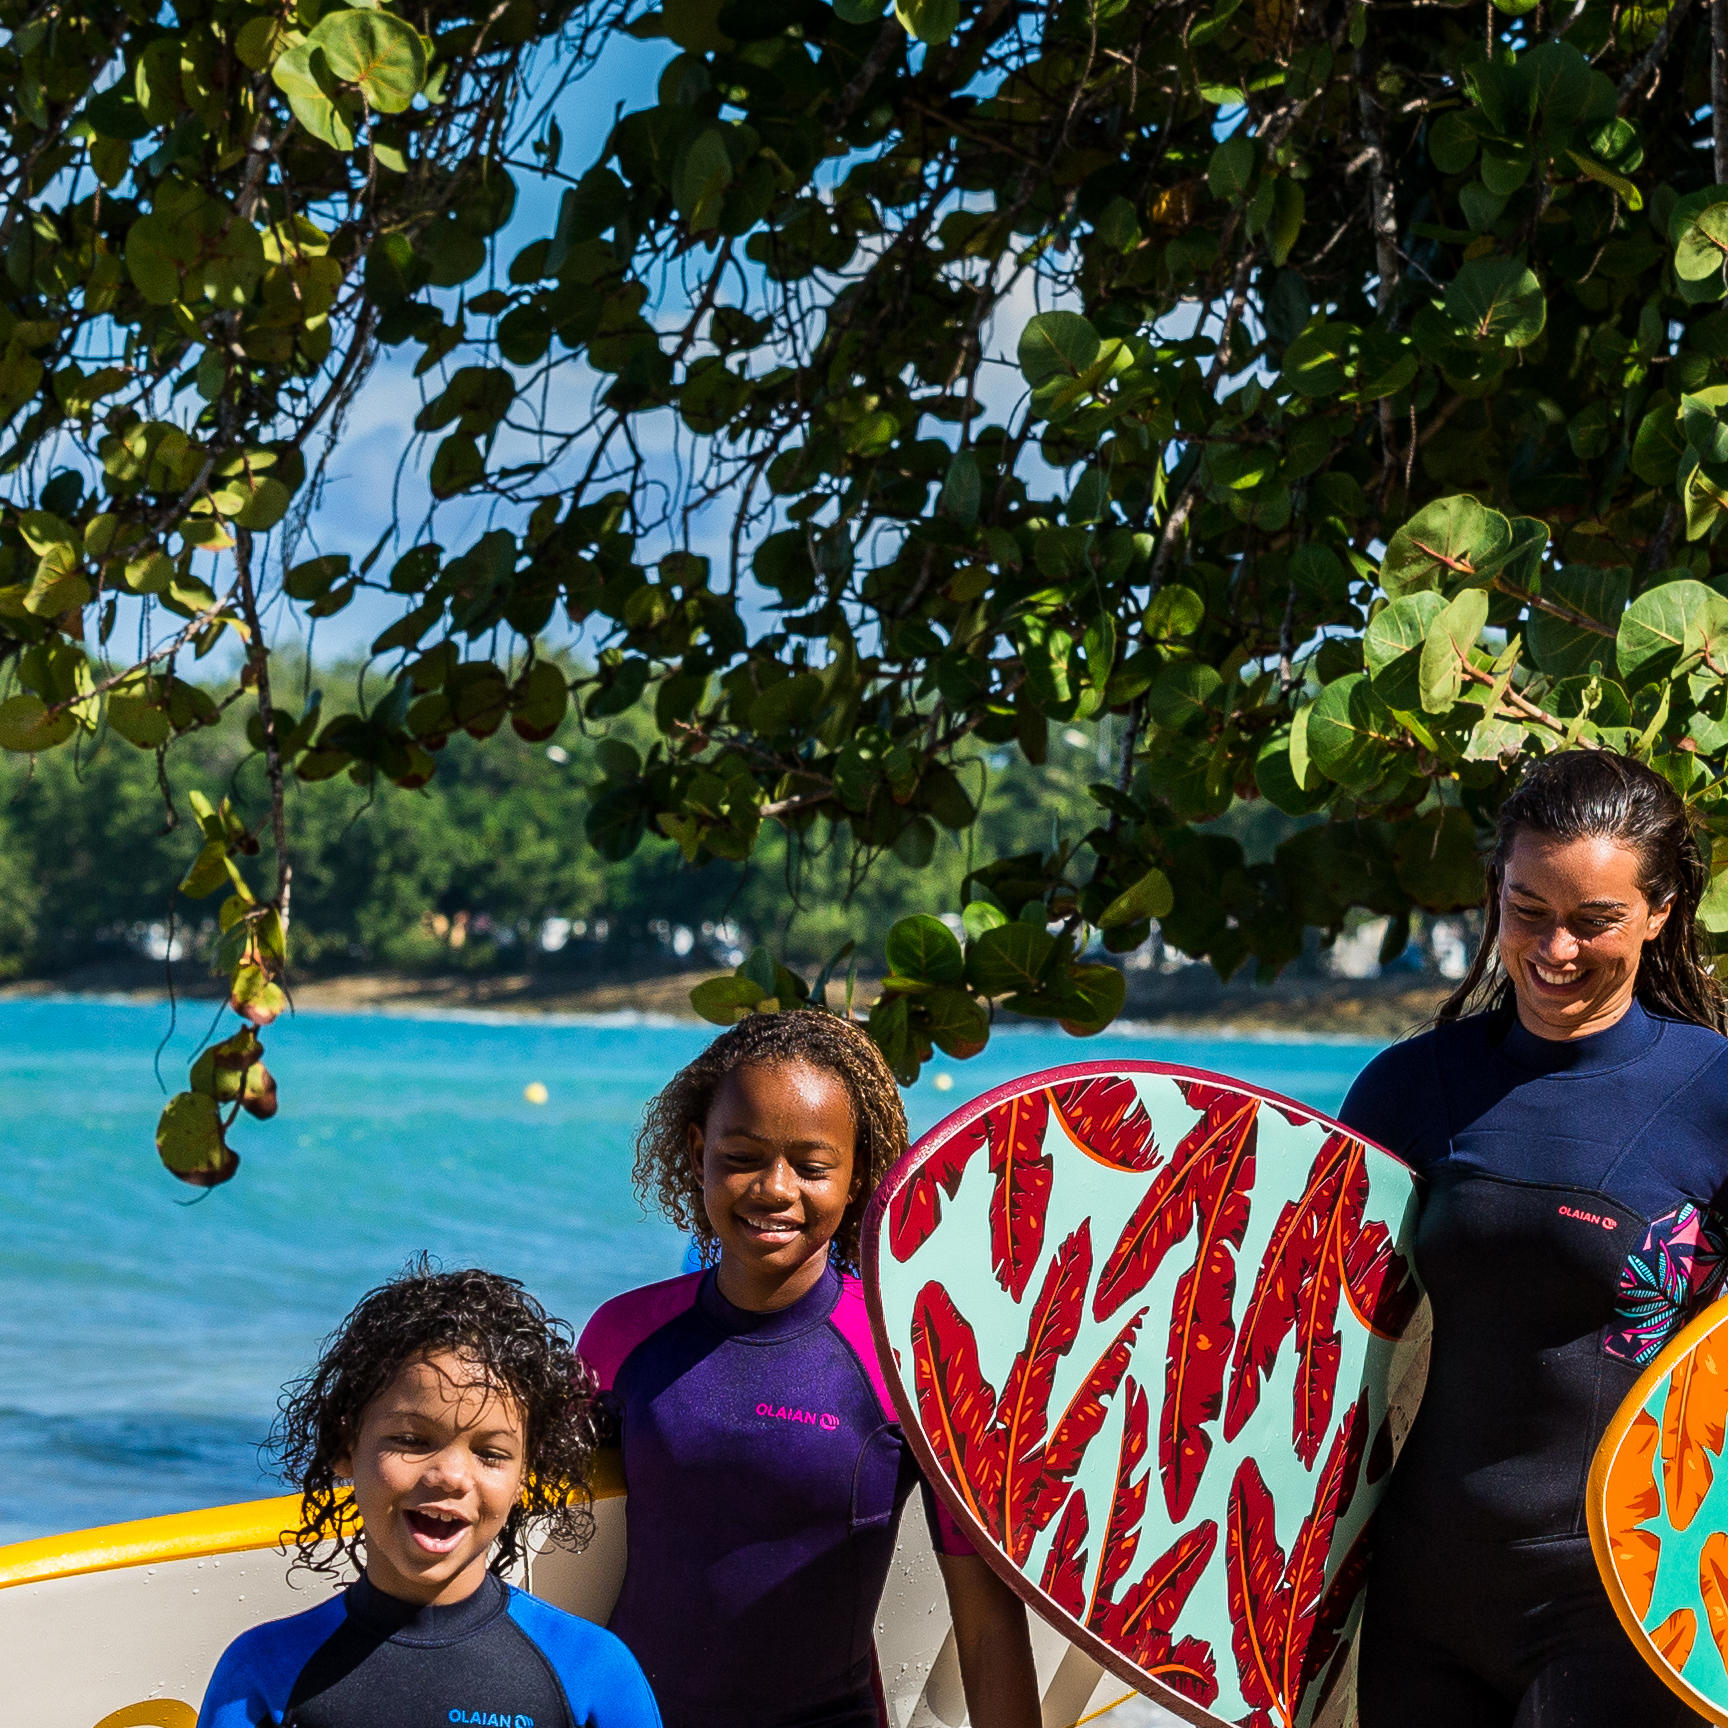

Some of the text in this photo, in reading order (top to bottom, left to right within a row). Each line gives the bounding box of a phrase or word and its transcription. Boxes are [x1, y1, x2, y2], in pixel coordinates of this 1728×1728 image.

[1558, 1206, 1601, 1225] OLAIAN
[755, 1403, 817, 1425] OLAIAN
[448, 1708, 511, 1728] OLAIAN
